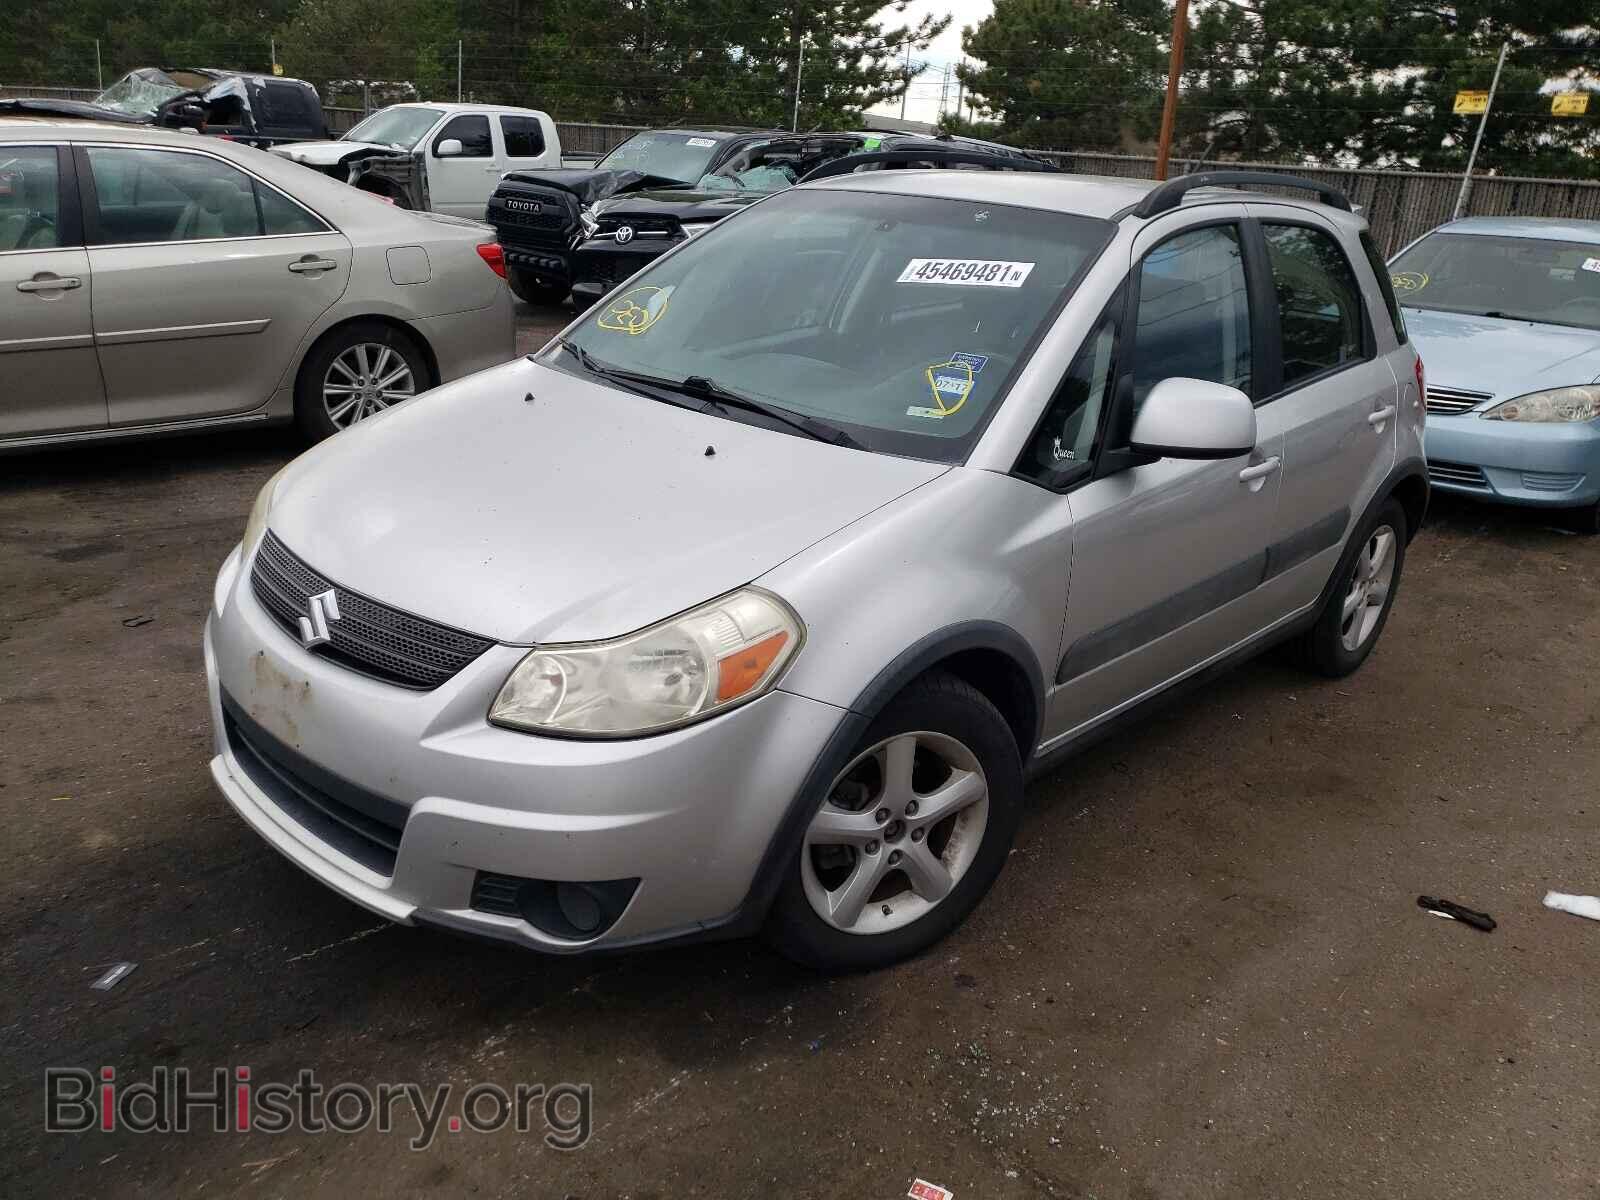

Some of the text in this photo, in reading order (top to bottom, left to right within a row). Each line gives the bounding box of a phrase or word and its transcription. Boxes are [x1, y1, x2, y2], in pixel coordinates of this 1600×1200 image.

[507, 200, 540, 212] TOYOTA
[915, 261, 1013, 282] 45469481
[1053, 445, 1075, 461] Queen
